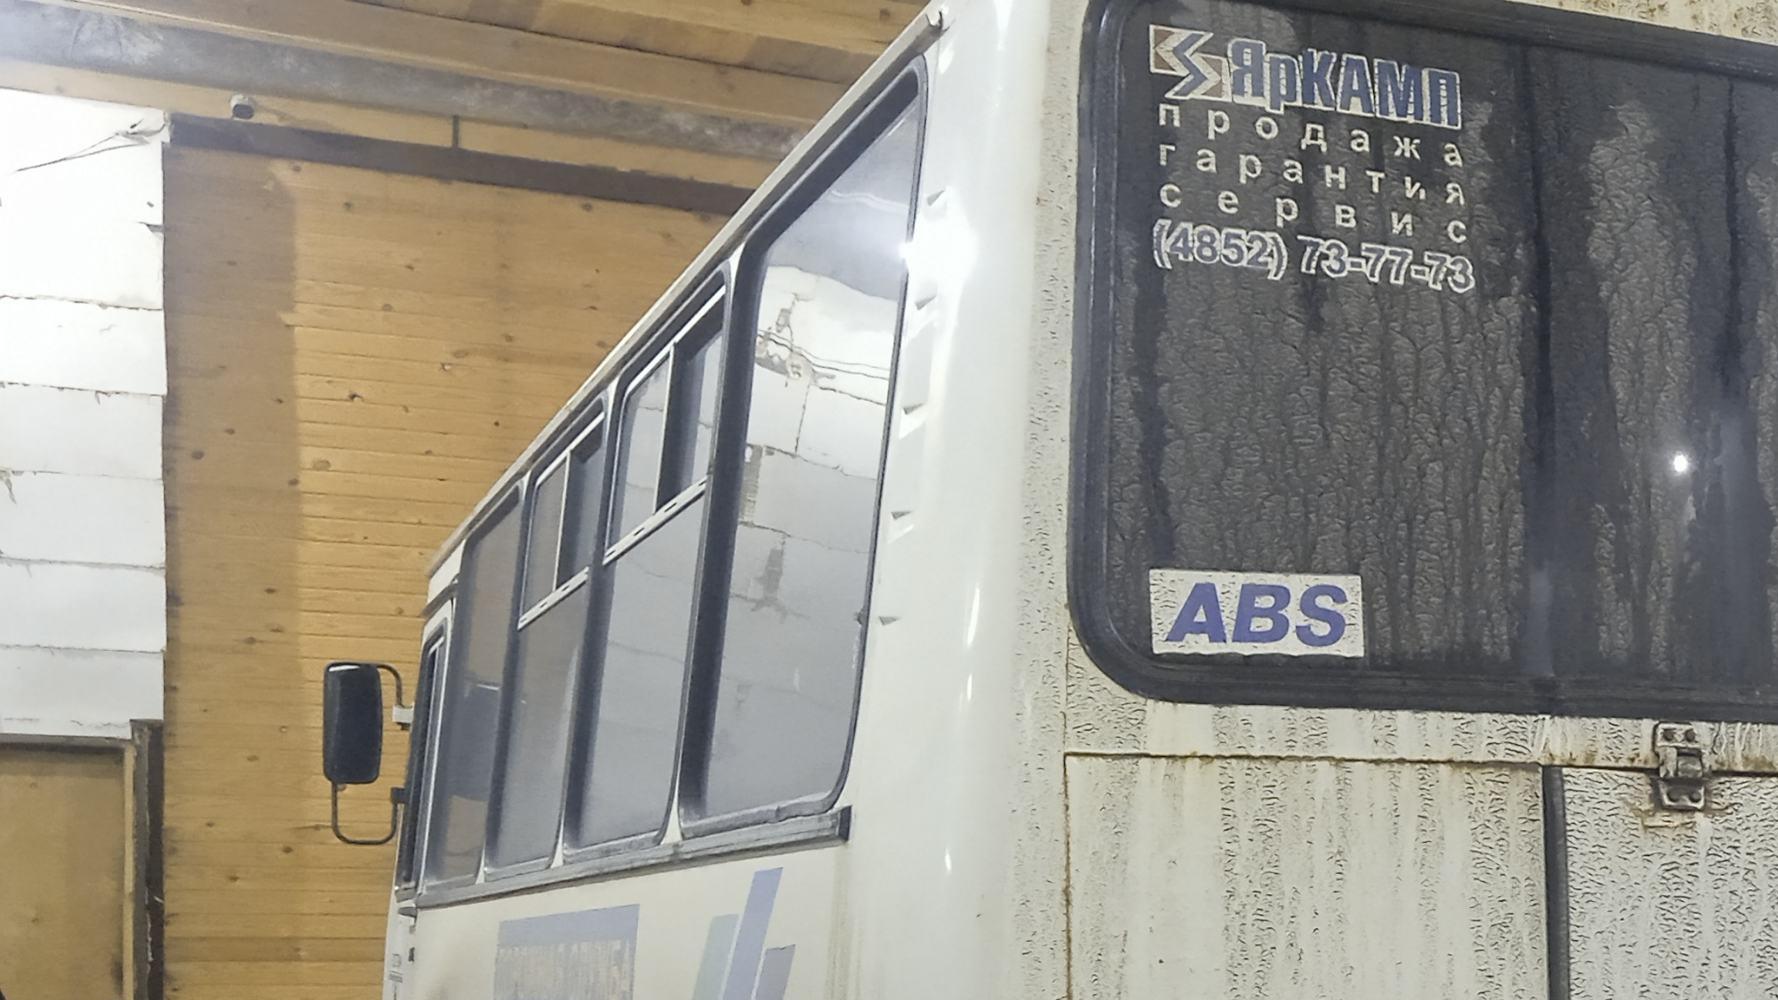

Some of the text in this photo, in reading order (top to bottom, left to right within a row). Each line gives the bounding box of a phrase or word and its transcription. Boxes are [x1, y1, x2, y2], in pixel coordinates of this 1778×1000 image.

[1227, 38, 1462, 129] ЯрКАМП
[1158, 104, 1463, 168] продажа
[1158, 143, 1466, 206] гарантия
[1159, 181, 1468, 244] сервис
[1153, 218, 1476, 294] (4852) 73-77-73
[1166, 582, 1349, 647] ABS
